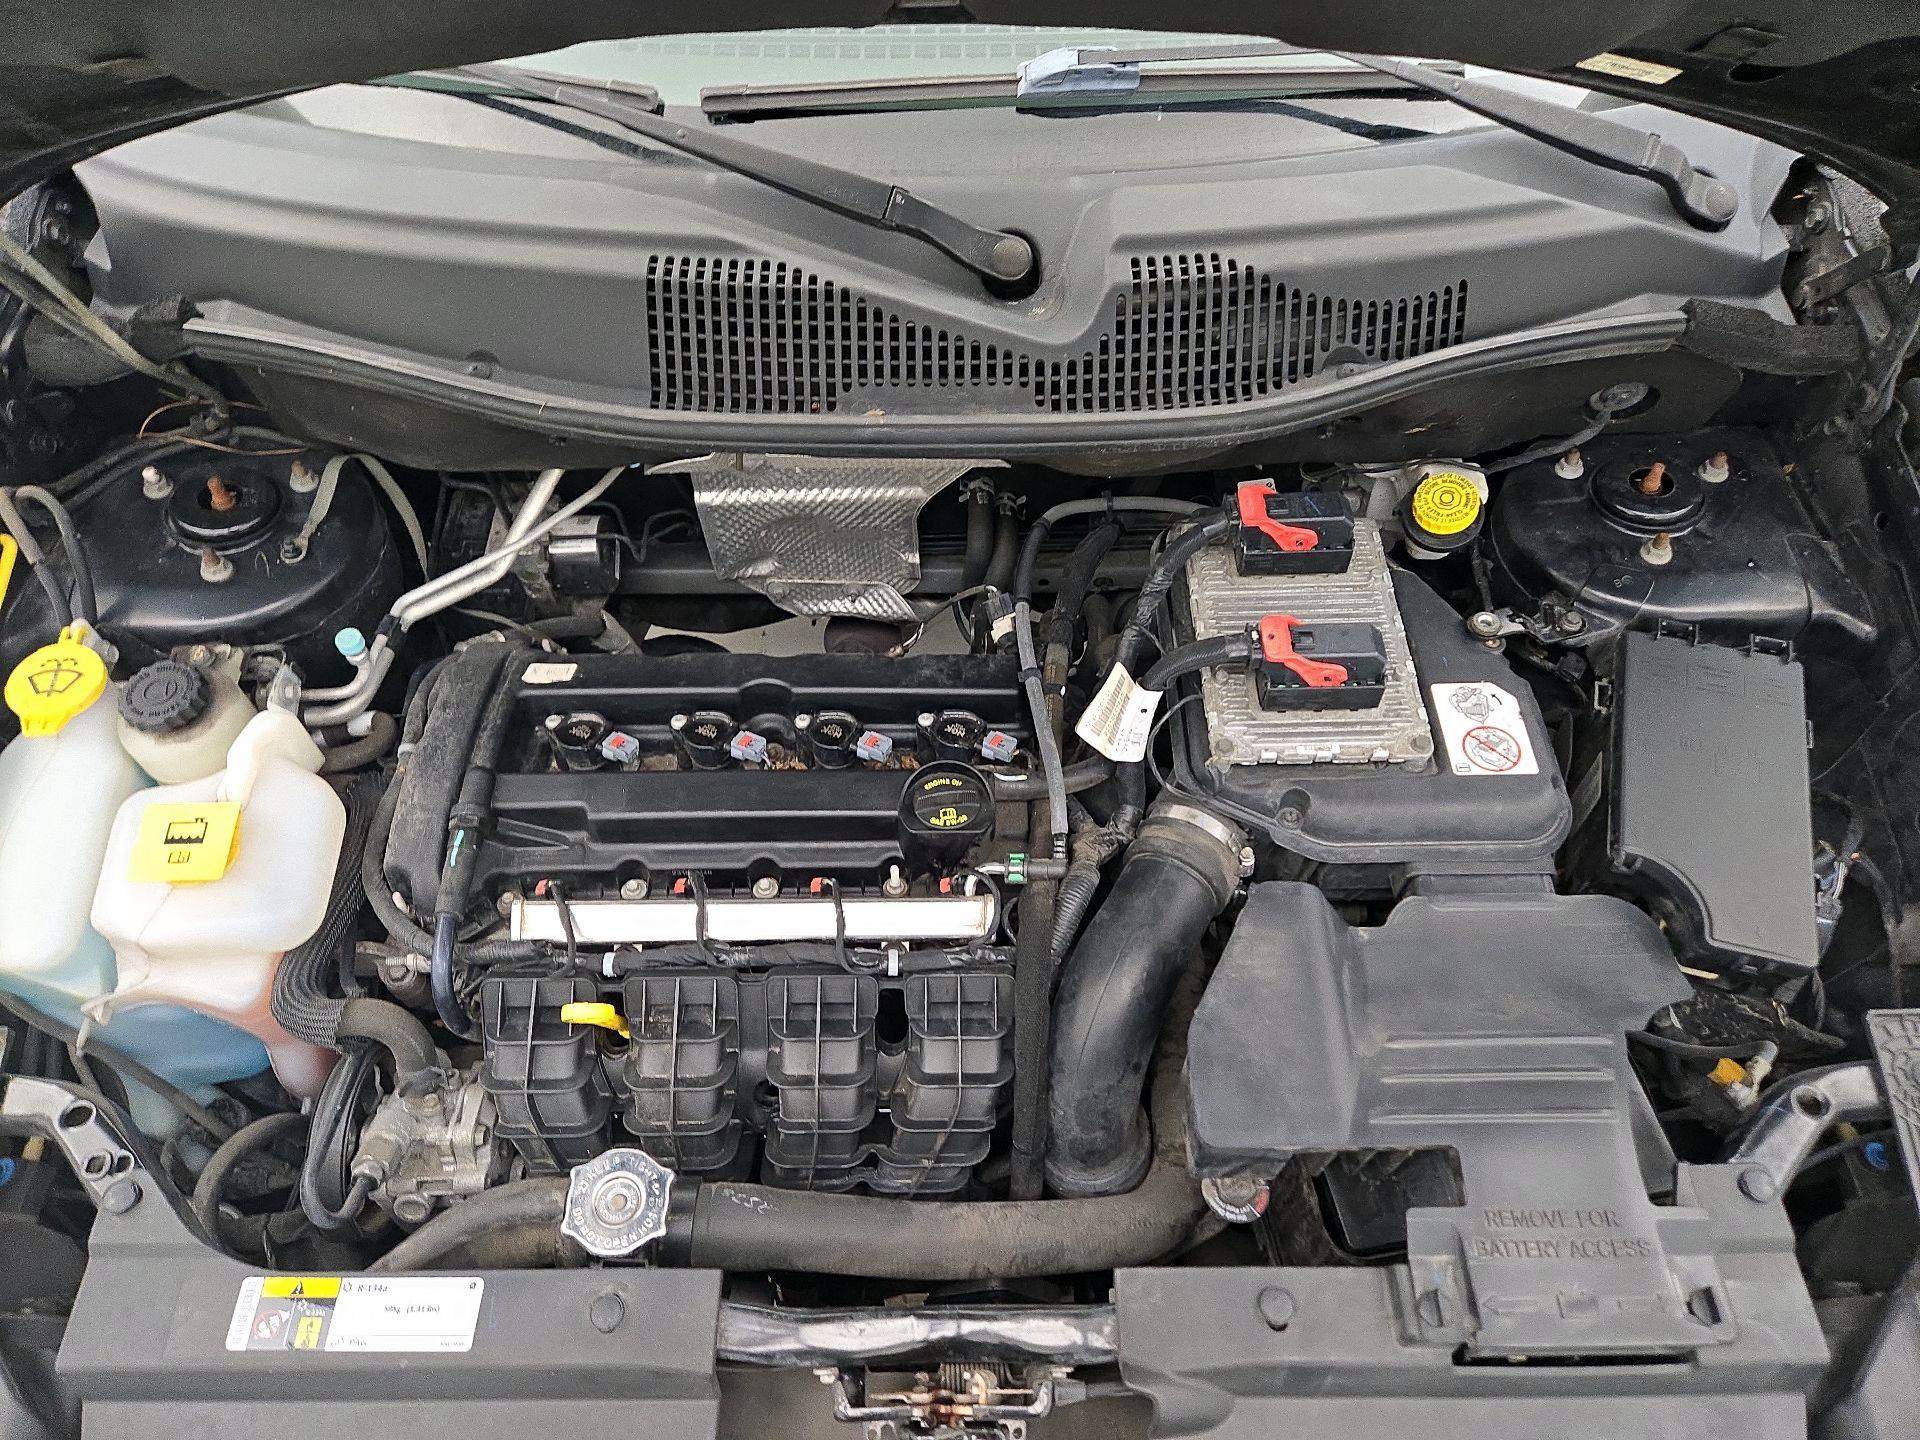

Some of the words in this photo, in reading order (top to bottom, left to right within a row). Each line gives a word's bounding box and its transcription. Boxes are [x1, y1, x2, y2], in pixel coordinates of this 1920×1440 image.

[924, 777, 950, 791] ENGINE
[1483, 1208, 1566, 1230] REMOVE
[1575, 1208, 1623, 1230] FOR
[603, 1231, 638, 1249] OPEN
[1474, 1238, 1560, 1258] BATTERY
[1569, 1239, 1651, 1259] ACCESS
